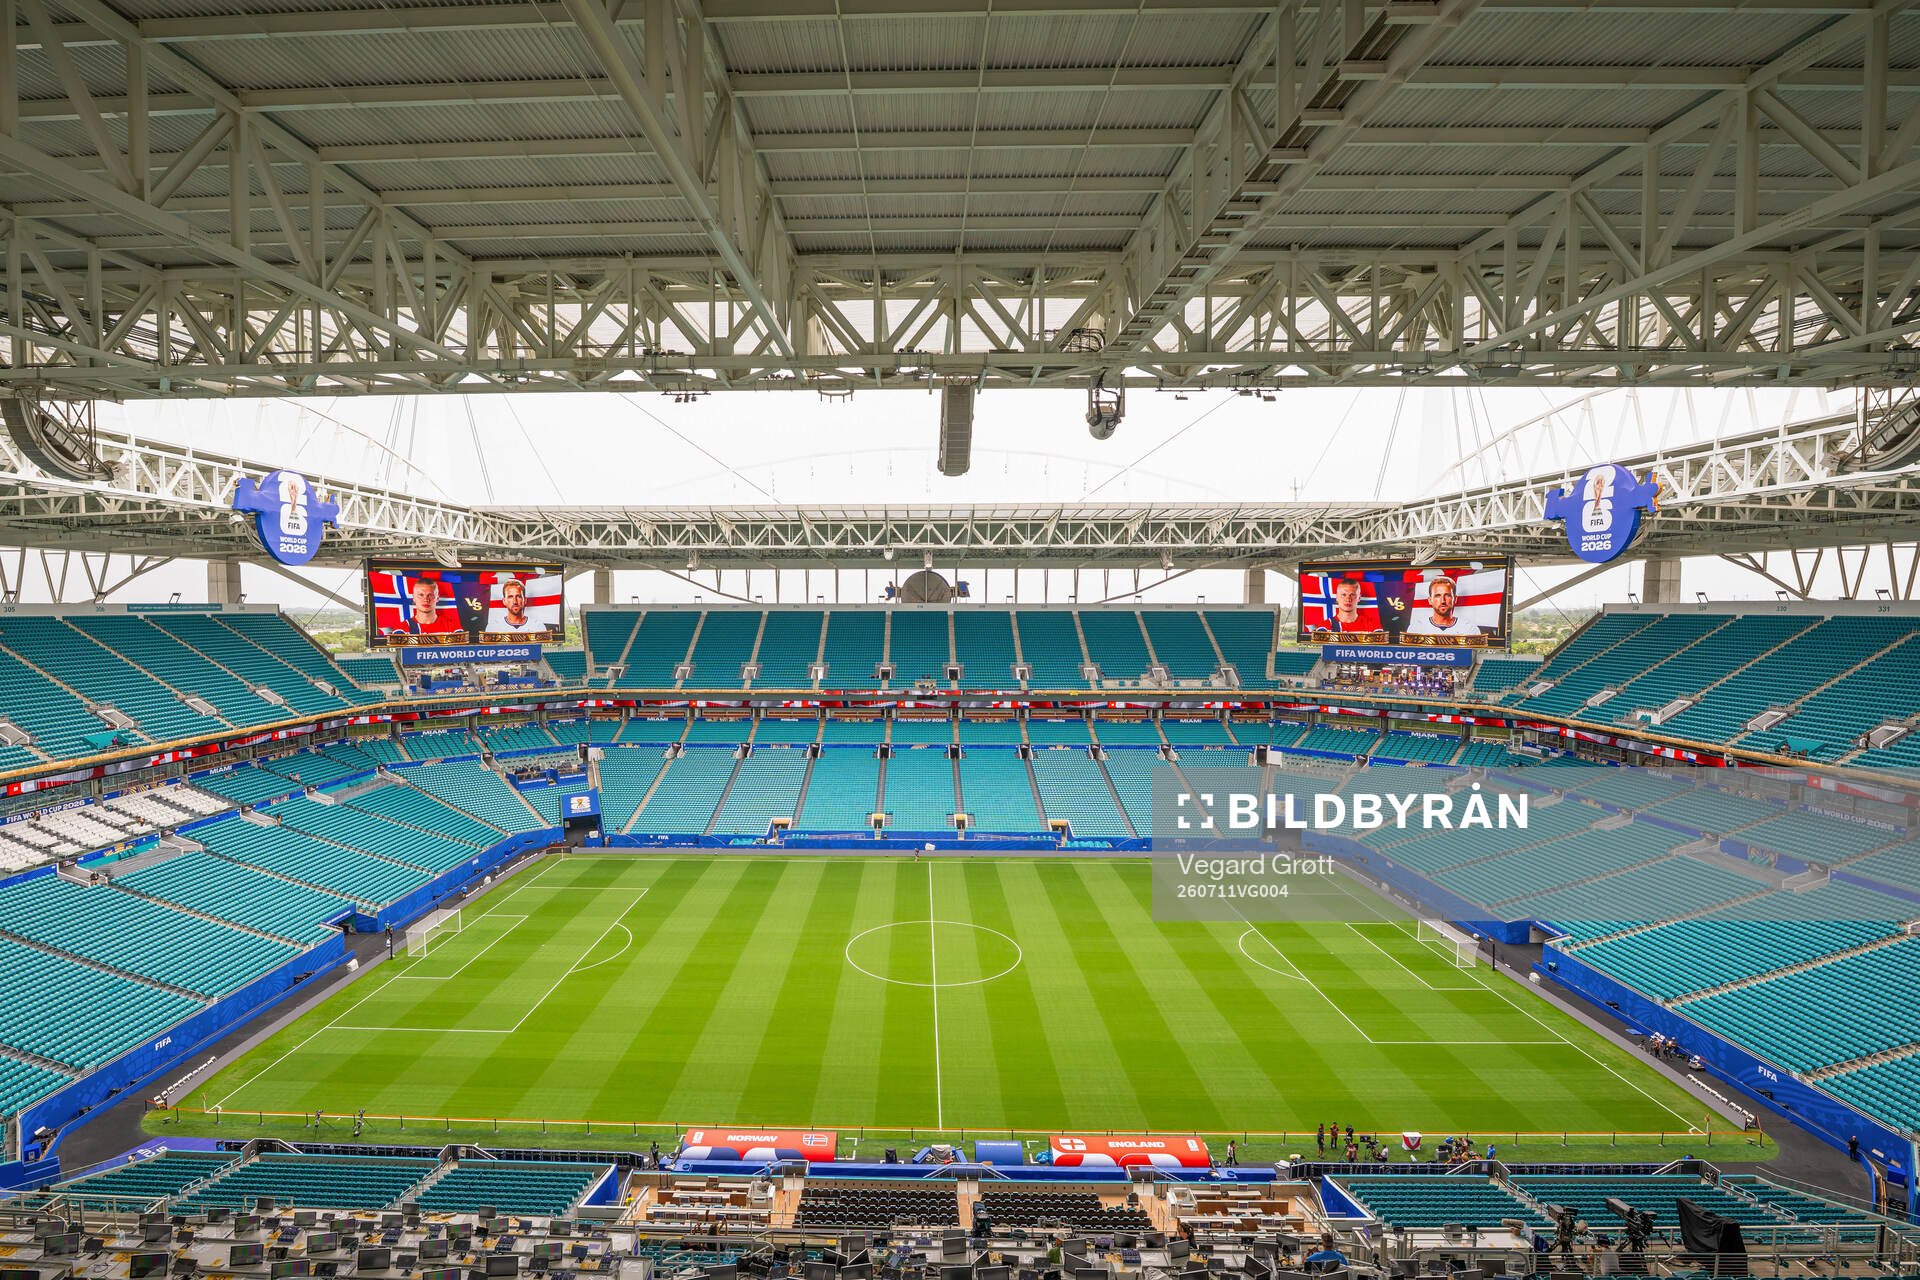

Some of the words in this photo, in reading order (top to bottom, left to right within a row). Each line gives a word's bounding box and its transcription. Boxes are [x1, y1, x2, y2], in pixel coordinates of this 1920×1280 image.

[287, 522, 301, 530] FIFA
[280, 536, 297, 544] WORLD
[1581, 534, 1600, 542] WORLD
[280, 543, 307, 554] 2026
[1581, 540, 1612, 552] 2026
[465, 597, 483, 611] VS
[1386, 596, 1405, 611] VS
[417, 651, 439, 660] FIFA
[440, 650, 475, 659] WORLD
[476, 649, 496, 658] CUP
[497, 648, 530, 657] 2026
[1335, 649, 1356, 658] FIFA
[1357, 649, 1395, 660] WORLD
[1396, 651, 1416, 660] CUP
[1417, 652, 1456, 661] 2026
[1411, 731, 1438, 739] MIAMI
[209, 765, 232, 775] MIAMI
[1647, 769, 1673, 780] MIAMI
[6, 814, 22, 824] FIFA
[22, 808, 48, 820] WOLD
[49, 806, 62, 815] CUP
[63, 799, 85, 810] 2026
[1808, 805, 1824, 816] FIFA
[1824, 808, 1850, 821] WORLD
[1851, 815, 1867, 825] CUP
[1867, 819, 1895, 832] 2026
[154, 1036, 172, 1051] FIFA
[1758, 1065, 1778, 1083] FIFA
[727, 1134, 778, 1143] NORWAY
[1108, 1141, 1165, 1149] ENGLAND
